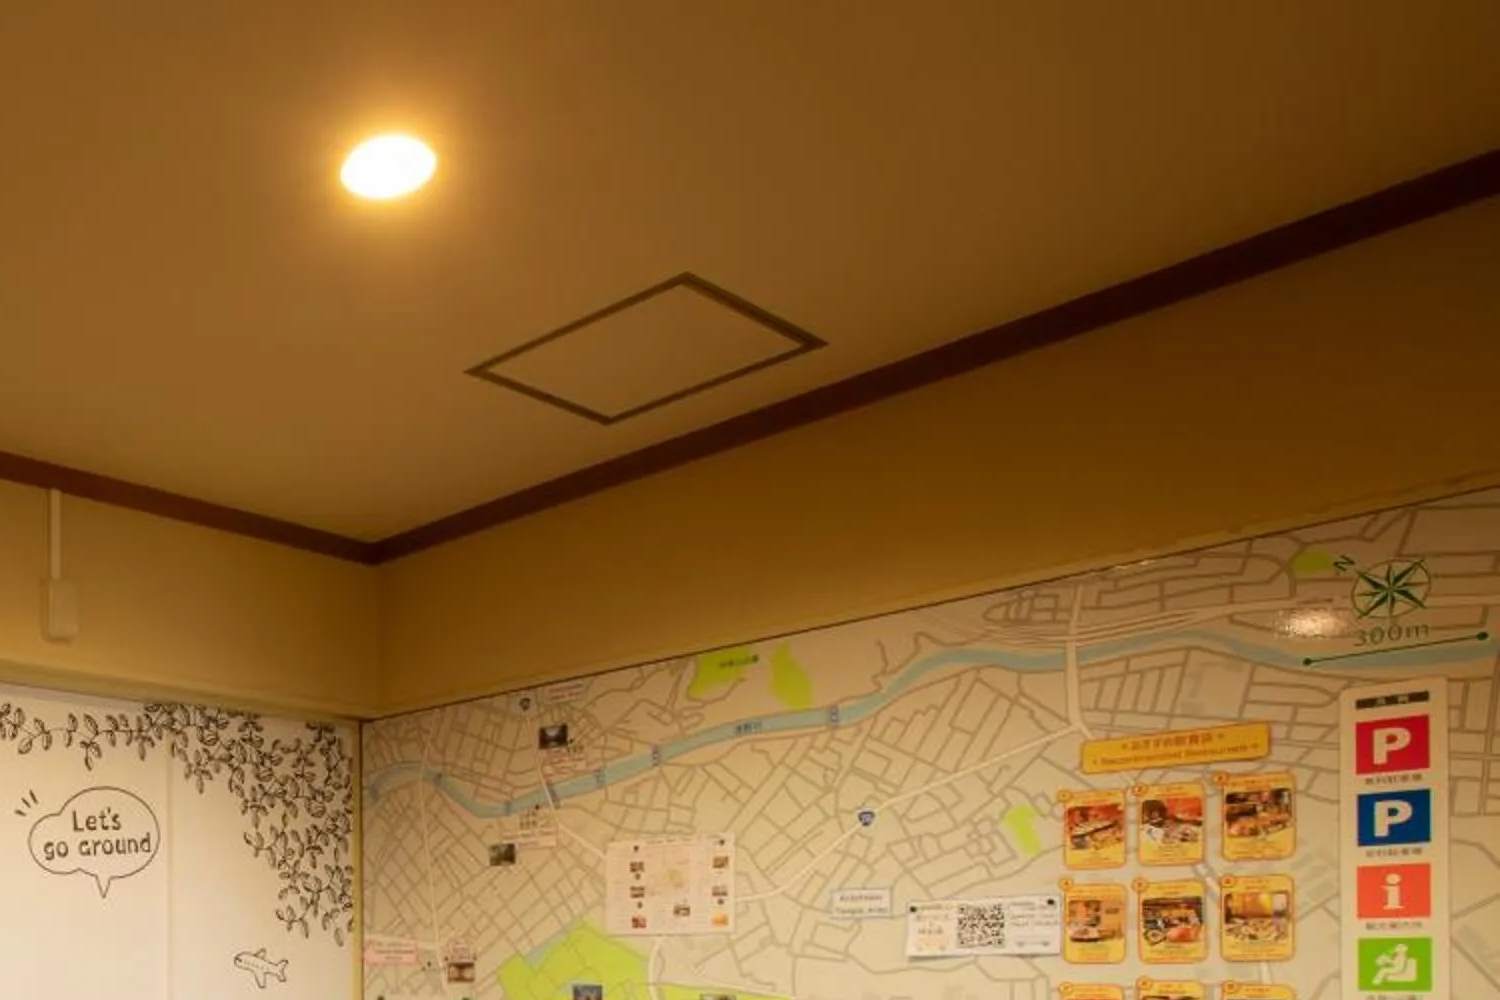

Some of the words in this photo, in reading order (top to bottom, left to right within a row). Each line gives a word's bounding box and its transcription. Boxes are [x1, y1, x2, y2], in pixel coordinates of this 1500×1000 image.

[1372, 727, 1411, 765] P
[72, 805, 122, 833] Let's
[1374, 800, 1413, 837] P
[44, 840, 70, 861] go
